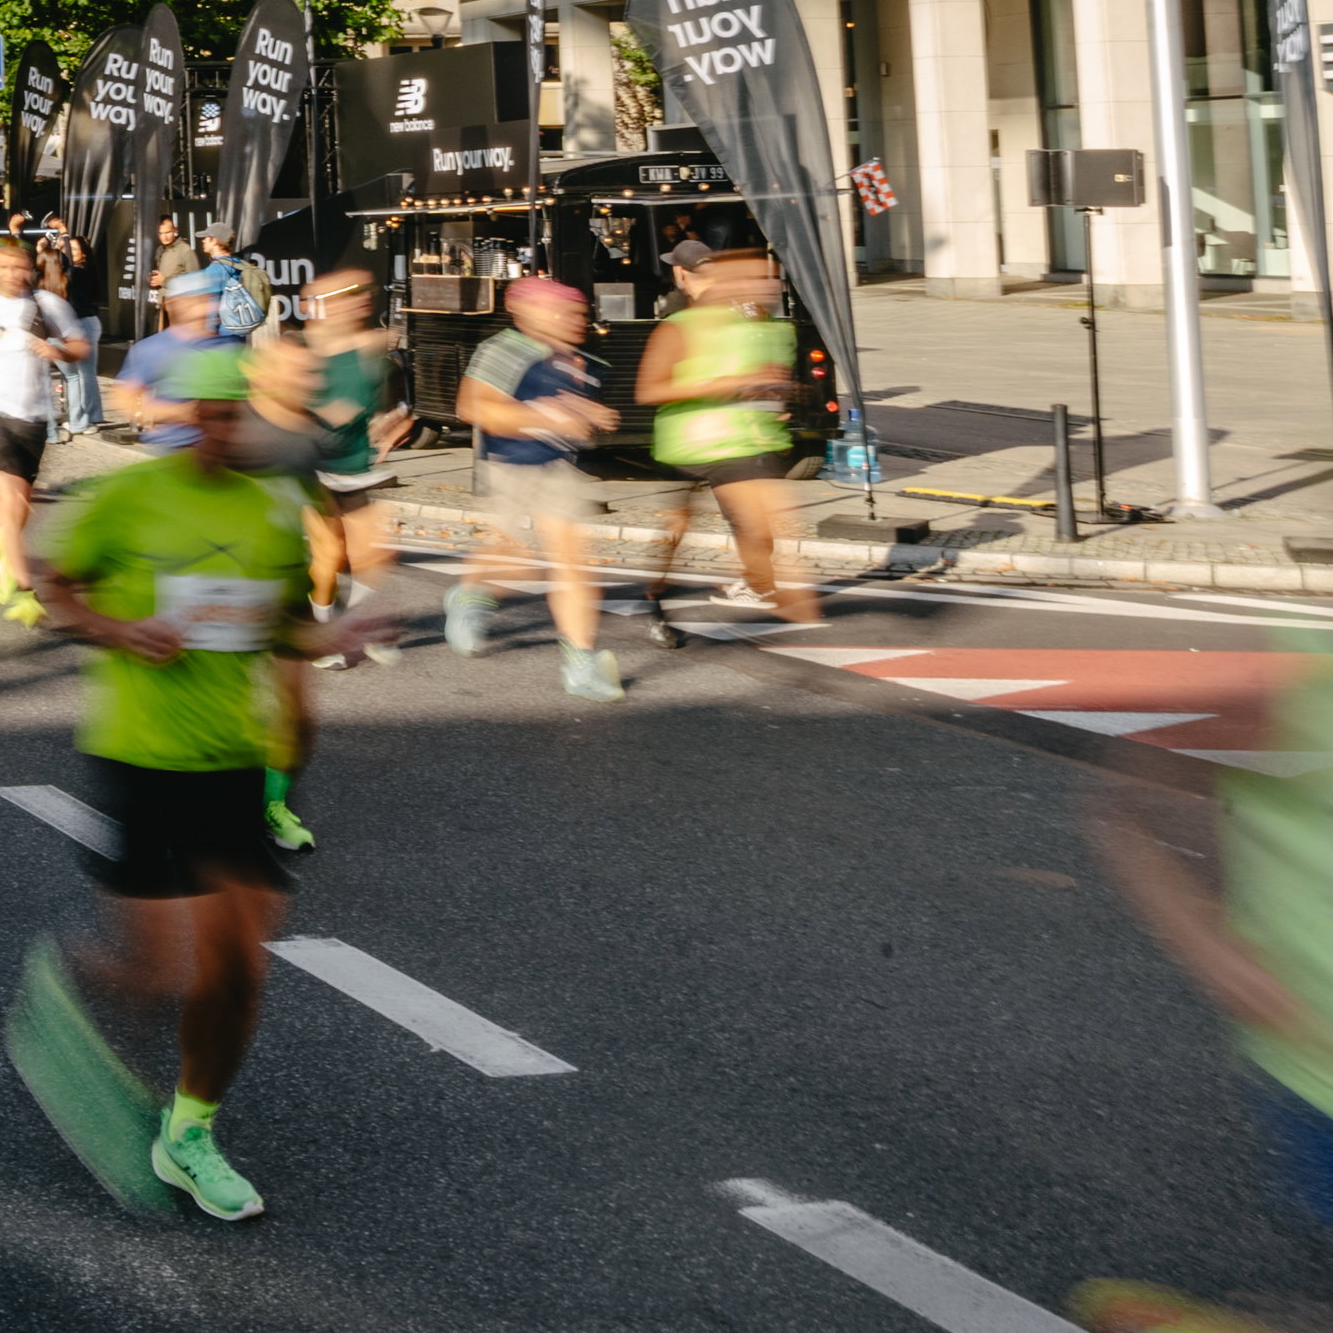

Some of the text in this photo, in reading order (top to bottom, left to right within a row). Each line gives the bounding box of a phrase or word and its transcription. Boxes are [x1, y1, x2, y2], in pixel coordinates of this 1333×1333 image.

[149, 38, 174, 70] Run
[255, 28, 293, 65] Run
[27, 67, 54, 94] Run
[104, 53, 139, 80] Ru
[246, 60, 292, 93] your
[145, 68, 175, 96] your
[24, 90, 54, 115] your
[143, 93, 174, 124] way.
[242, 87, 290, 123] way.
[21, 111, 47, 138] way.
[433, 147, 515, 175] Run your way.
